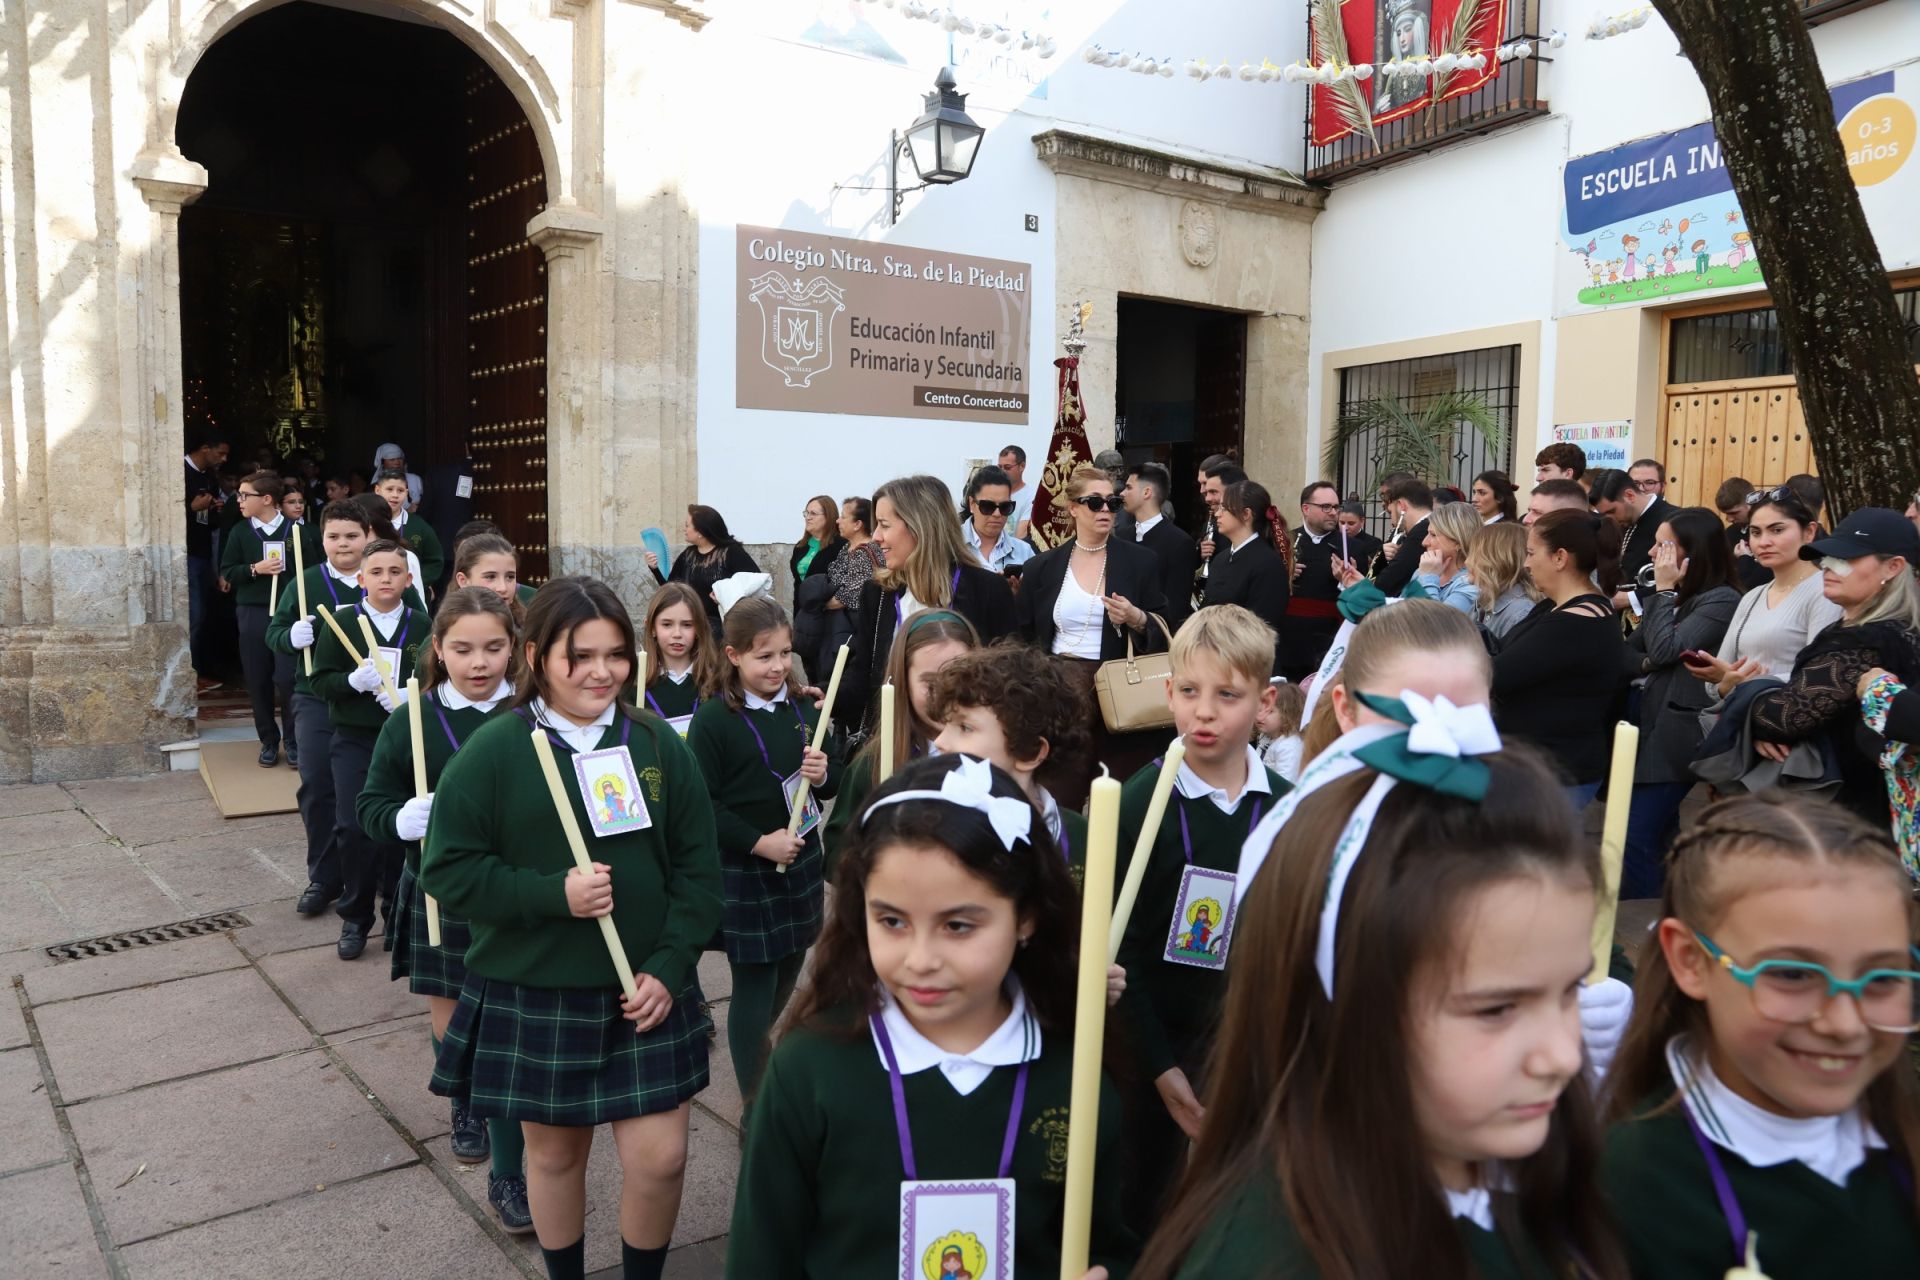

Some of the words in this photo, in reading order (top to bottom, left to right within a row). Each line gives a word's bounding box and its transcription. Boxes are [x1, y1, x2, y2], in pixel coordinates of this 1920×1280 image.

[1859, 116, 1892, 139] 0-3
[1848, 142, 1899, 166] años
[1581, 155, 1677, 200] ESCUELA
[1687, 141, 1725, 175] IN
[1028, 216, 1036, 230] 3
[749, 239, 825, 271] Colegio
[830, 248, 878, 274] Ntra.
[883, 255, 918, 279] Sra.
[923, 261, 944, 282] de
[948, 263, 963, 284] la
[968, 266, 1025, 292] Piedad
[850, 316, 935, 344] Educación
[940, 326, 995, 350] Infantil
[850, 347, 919, 373] Primaria
[924, 359, 933, 379] y
[938, 355, 1022, 381] Secundaria
[924, 391, 960, 405] Centro
[963, 394, 1023, 410] Concertado
[1588, 450, 1595, 460] de
[1597, 450, 1602, 460] la
[1603, 449, 1625, 460] Piedad
